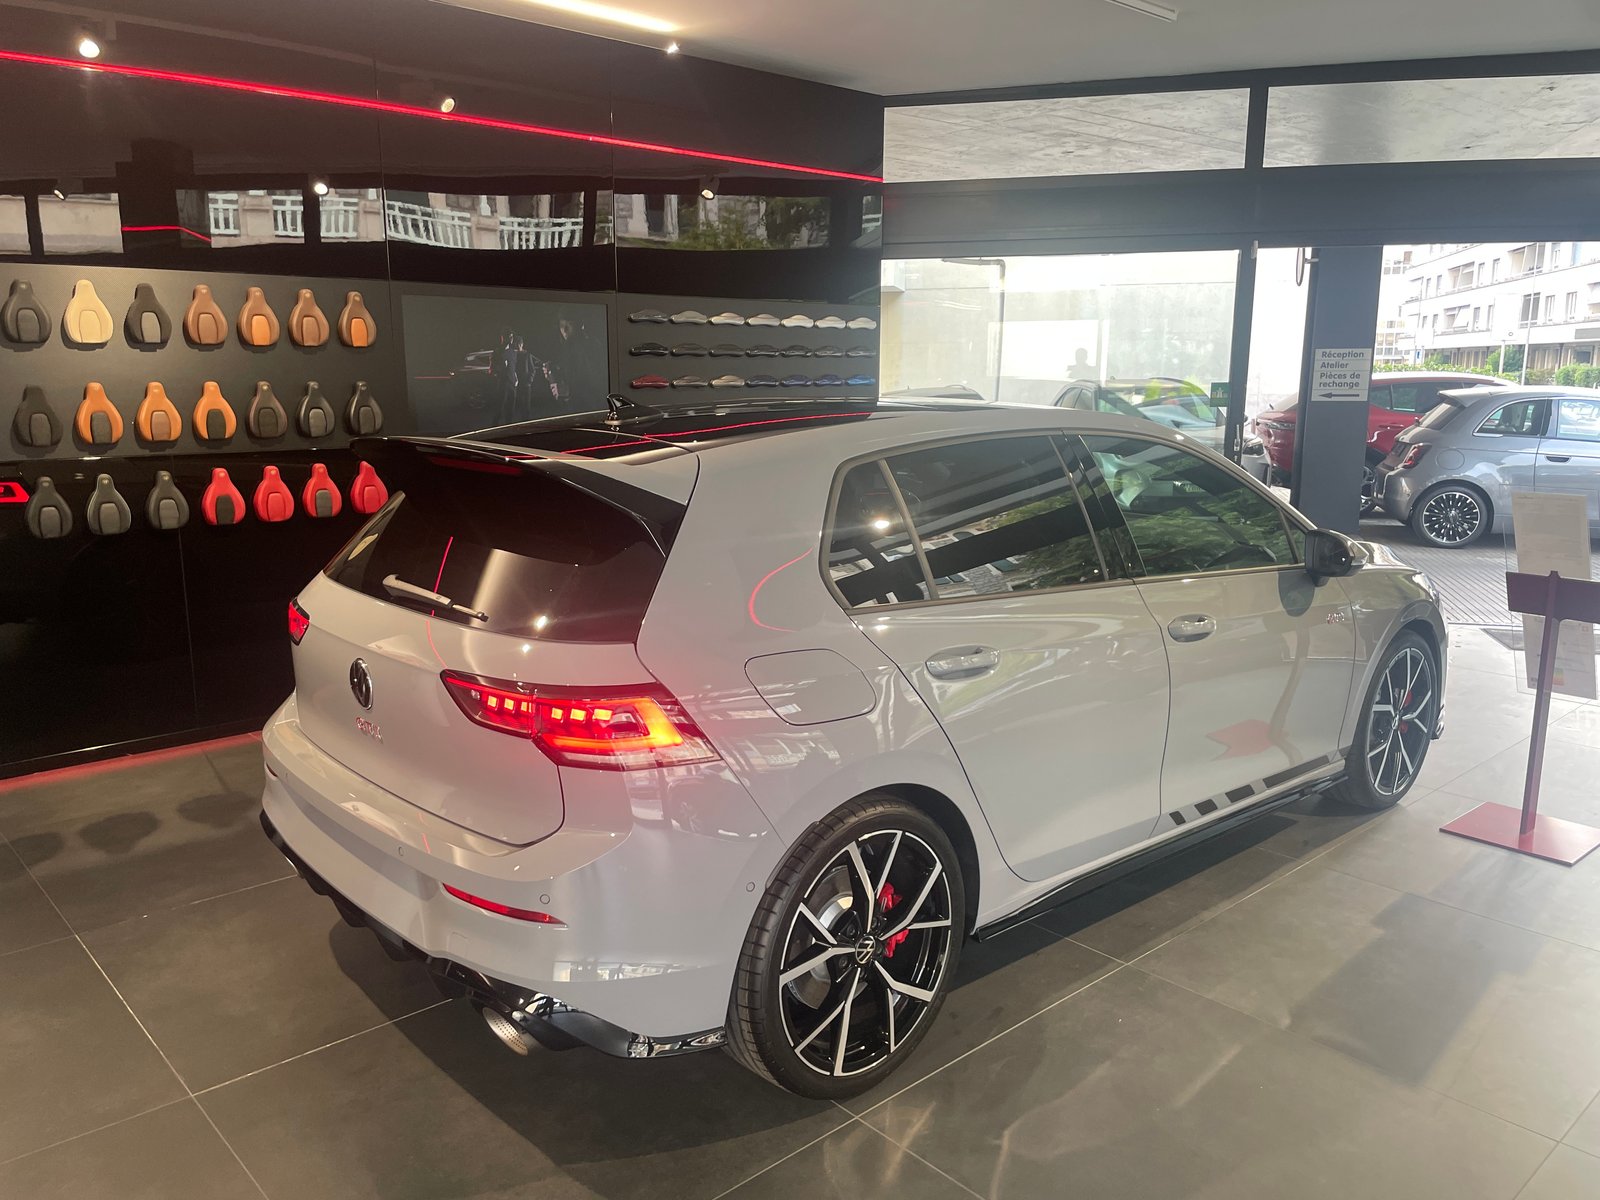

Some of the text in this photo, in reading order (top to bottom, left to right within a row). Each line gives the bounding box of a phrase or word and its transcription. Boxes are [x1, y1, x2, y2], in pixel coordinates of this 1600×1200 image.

[1321, 351, 1364, 360] Réception
[1320, 361, 1349, 369] Atelier
[1350, 371, 1361, 379] de
[1319, 380, 1360, 389] rechange
